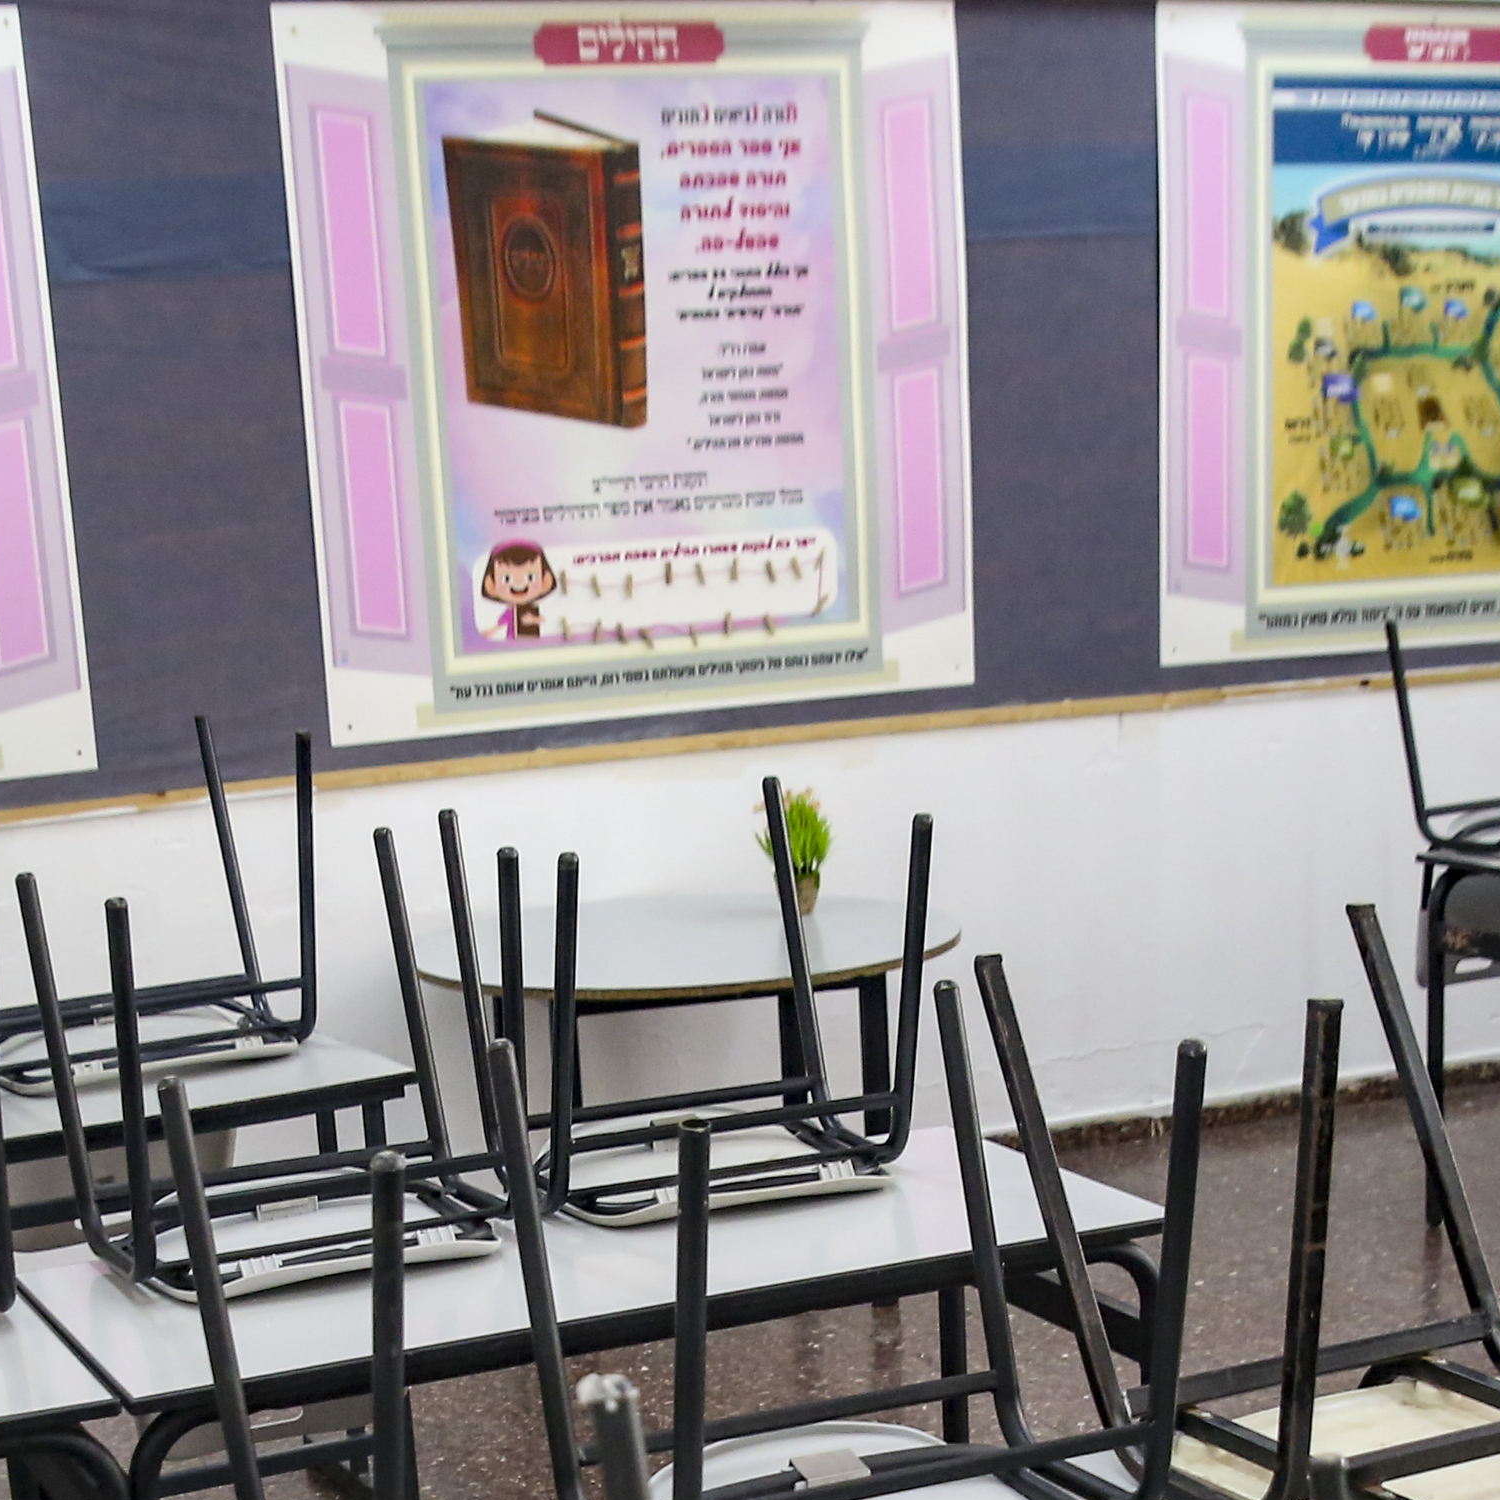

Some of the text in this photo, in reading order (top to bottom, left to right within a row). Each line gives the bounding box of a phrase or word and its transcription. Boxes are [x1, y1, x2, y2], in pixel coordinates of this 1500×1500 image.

[577, 25, 680, 62] תהילים
[739, 139, 772, 156] ספר
[779, 139, 801, 159] אני
